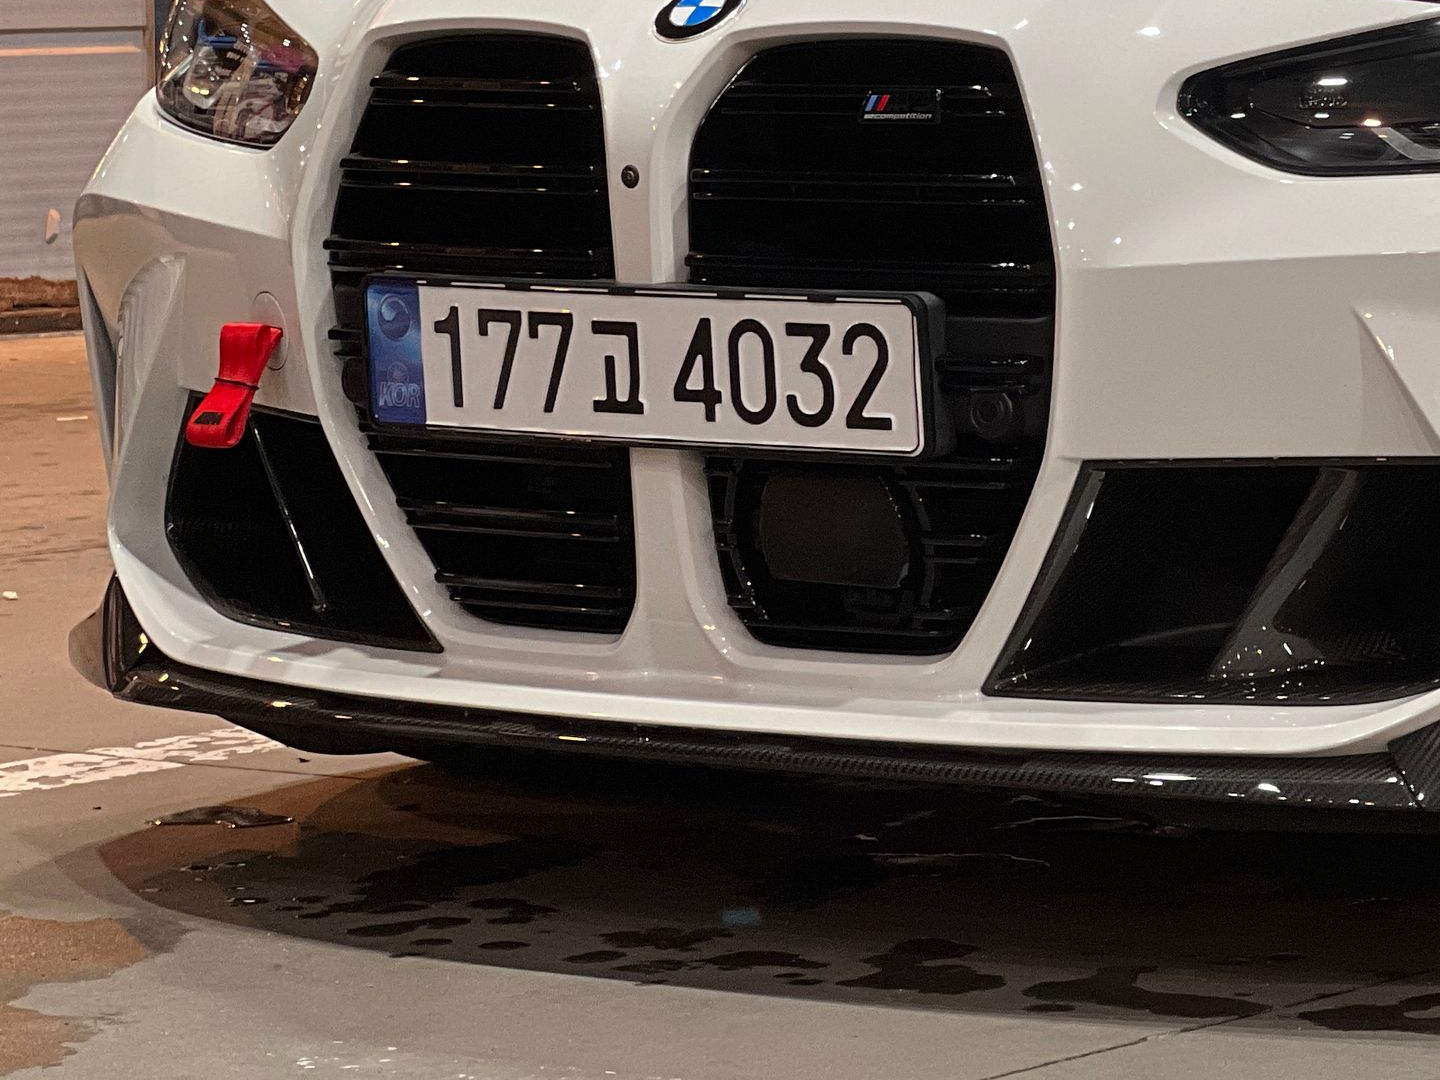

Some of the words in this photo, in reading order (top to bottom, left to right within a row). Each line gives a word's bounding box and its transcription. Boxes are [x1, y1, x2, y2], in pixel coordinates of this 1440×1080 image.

[377, 380, 421, 409] KOR
[434, 306, 645, 414] 177고
[673, 316, 894, 431] 4032
